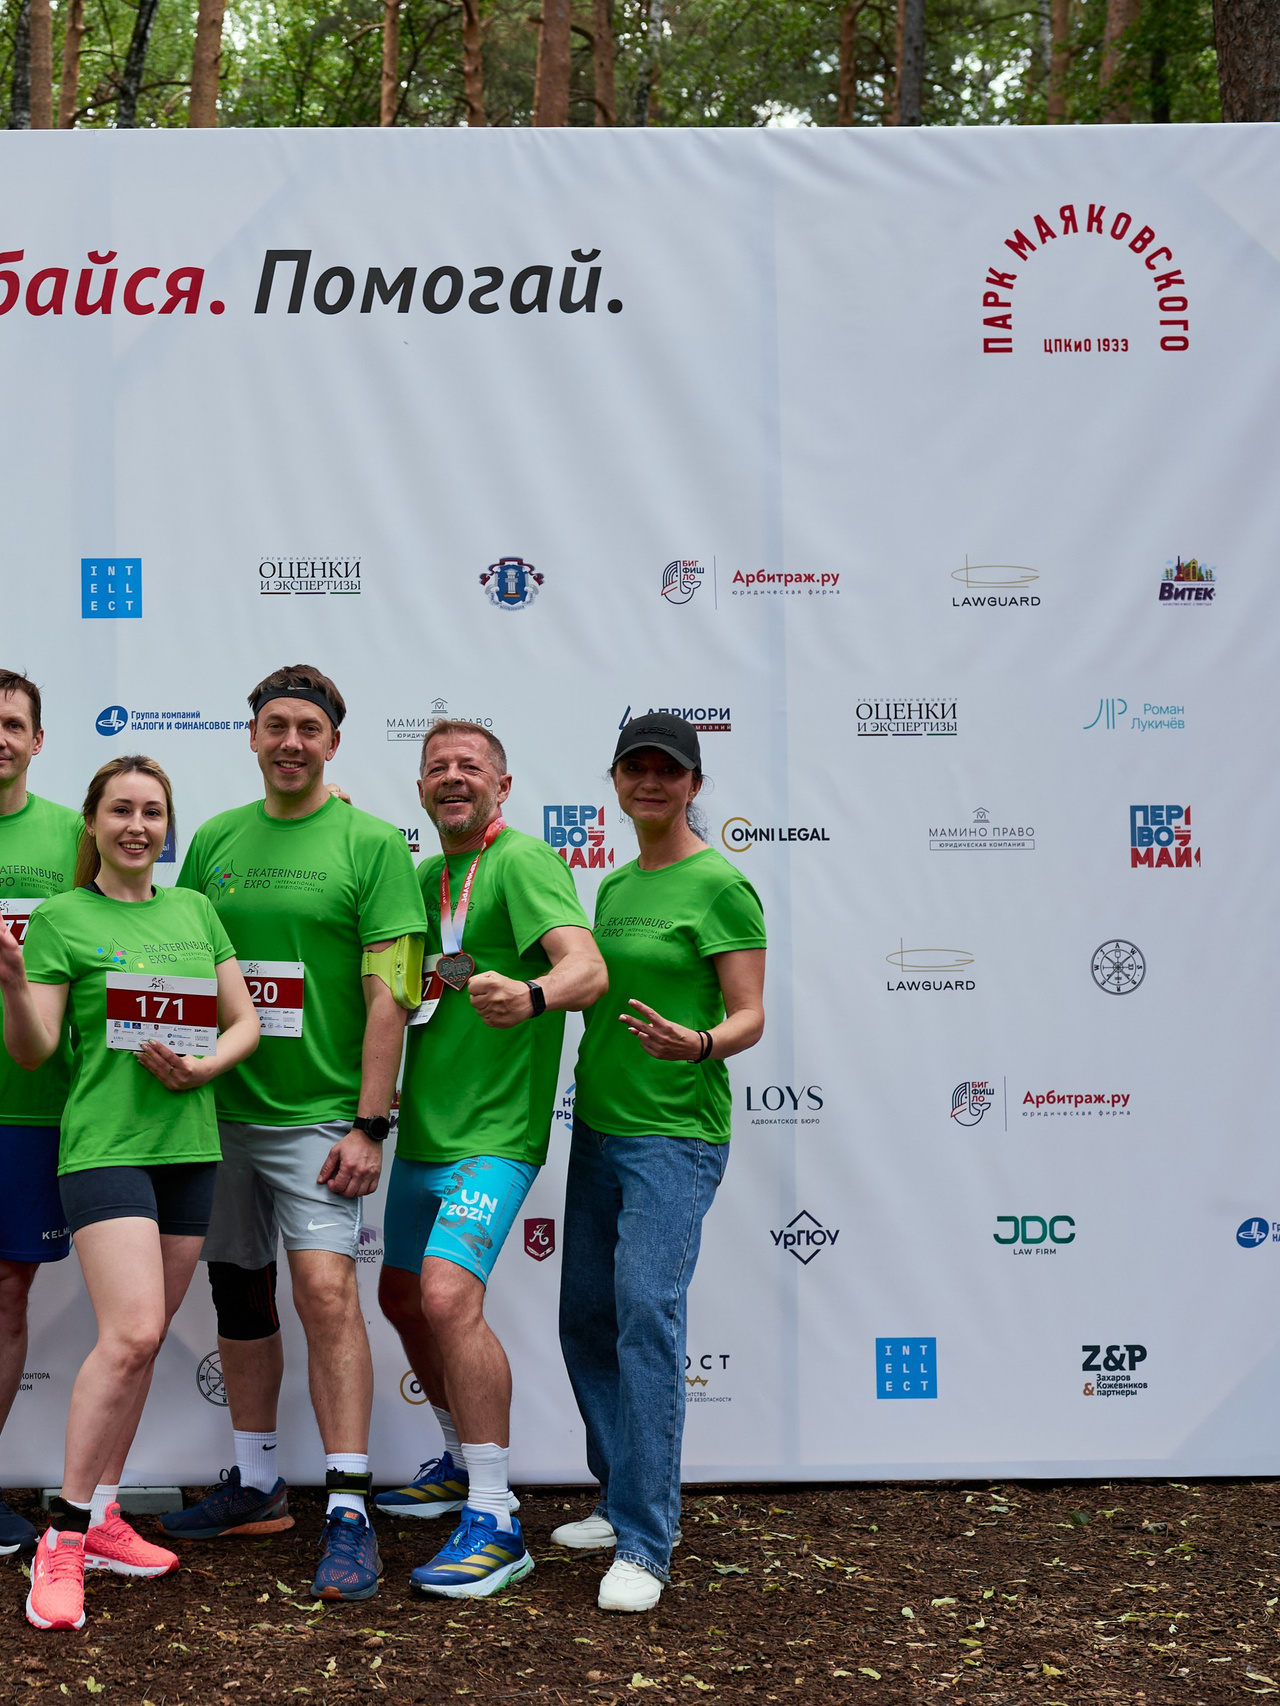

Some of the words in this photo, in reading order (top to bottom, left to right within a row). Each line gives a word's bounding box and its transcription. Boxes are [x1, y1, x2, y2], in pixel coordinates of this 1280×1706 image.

[254, 248, 623, 315] Помогай.
[982, 267, 1017, 353] ПАРК
[1004, 203, 1189, 352] МАЯКОВСКОГО
[1044, 338, 1091, 354] ЦПКиО
[1097, 338, 1128, 352] 1933
[259, 561, 361, 580] ОЦЕНКИ
[733, 569, 839, 587] Арбитраж.ру
[260, 580, 270, 590] И
[273, 580, 361, 590] ЭКСПЕРТИЗЫ
[953, 597, 1040, 606] LAWGUARD
[856, 703, 957, 721] ОЦЕНКИ
[1143, 703, 1184, 715] Роман
[131, 710, 159, 721] Группа
[161, 710, 201, 720] компаний
[131, 721, 164, 731] НАЛОГИ
[166, 721, 172, 730] И
[174, 720, 231, 730] ФИНАНСОВОЕ
[857, 722, 867, 732] И
[871, 721, 957, 732] ЭКСПЕРТИЗЫ
[1131, 717, 1185, 732] Лукичёв
[732, 828, 774, 842] OMNI
[779, 828, 830, 841] LEGAL
[929, 828, 987, 837] МАМИНО
[993, 827, 1035, 837] ПРАВО
[247, 868, 327, 881] EKATERINBURG
[243, 879, 270, 889] EXPO
[608, 917, 674, 929] EKATERINBURG
[601, 928, 623, 937] EXPO
[143, 941, 212, 953] EKATERINBURG
[148, 953, 177, 964] EXPO
[887, 981, 975, 991] LAWGUARD
[135, 995, 184, 1020] 171
[747, 1086, 823, 1111] LOYS
[1023, 1090, 1130, 1108] Арбитраж.ру
[1082, 1345, 1147, 1371] Z&P
[1096, 1373, 1131, 1382] Захаров
[1096, 1381, 1148, 1389] Кожевников
[1096, 1389, 1138, 1397] партнеры
